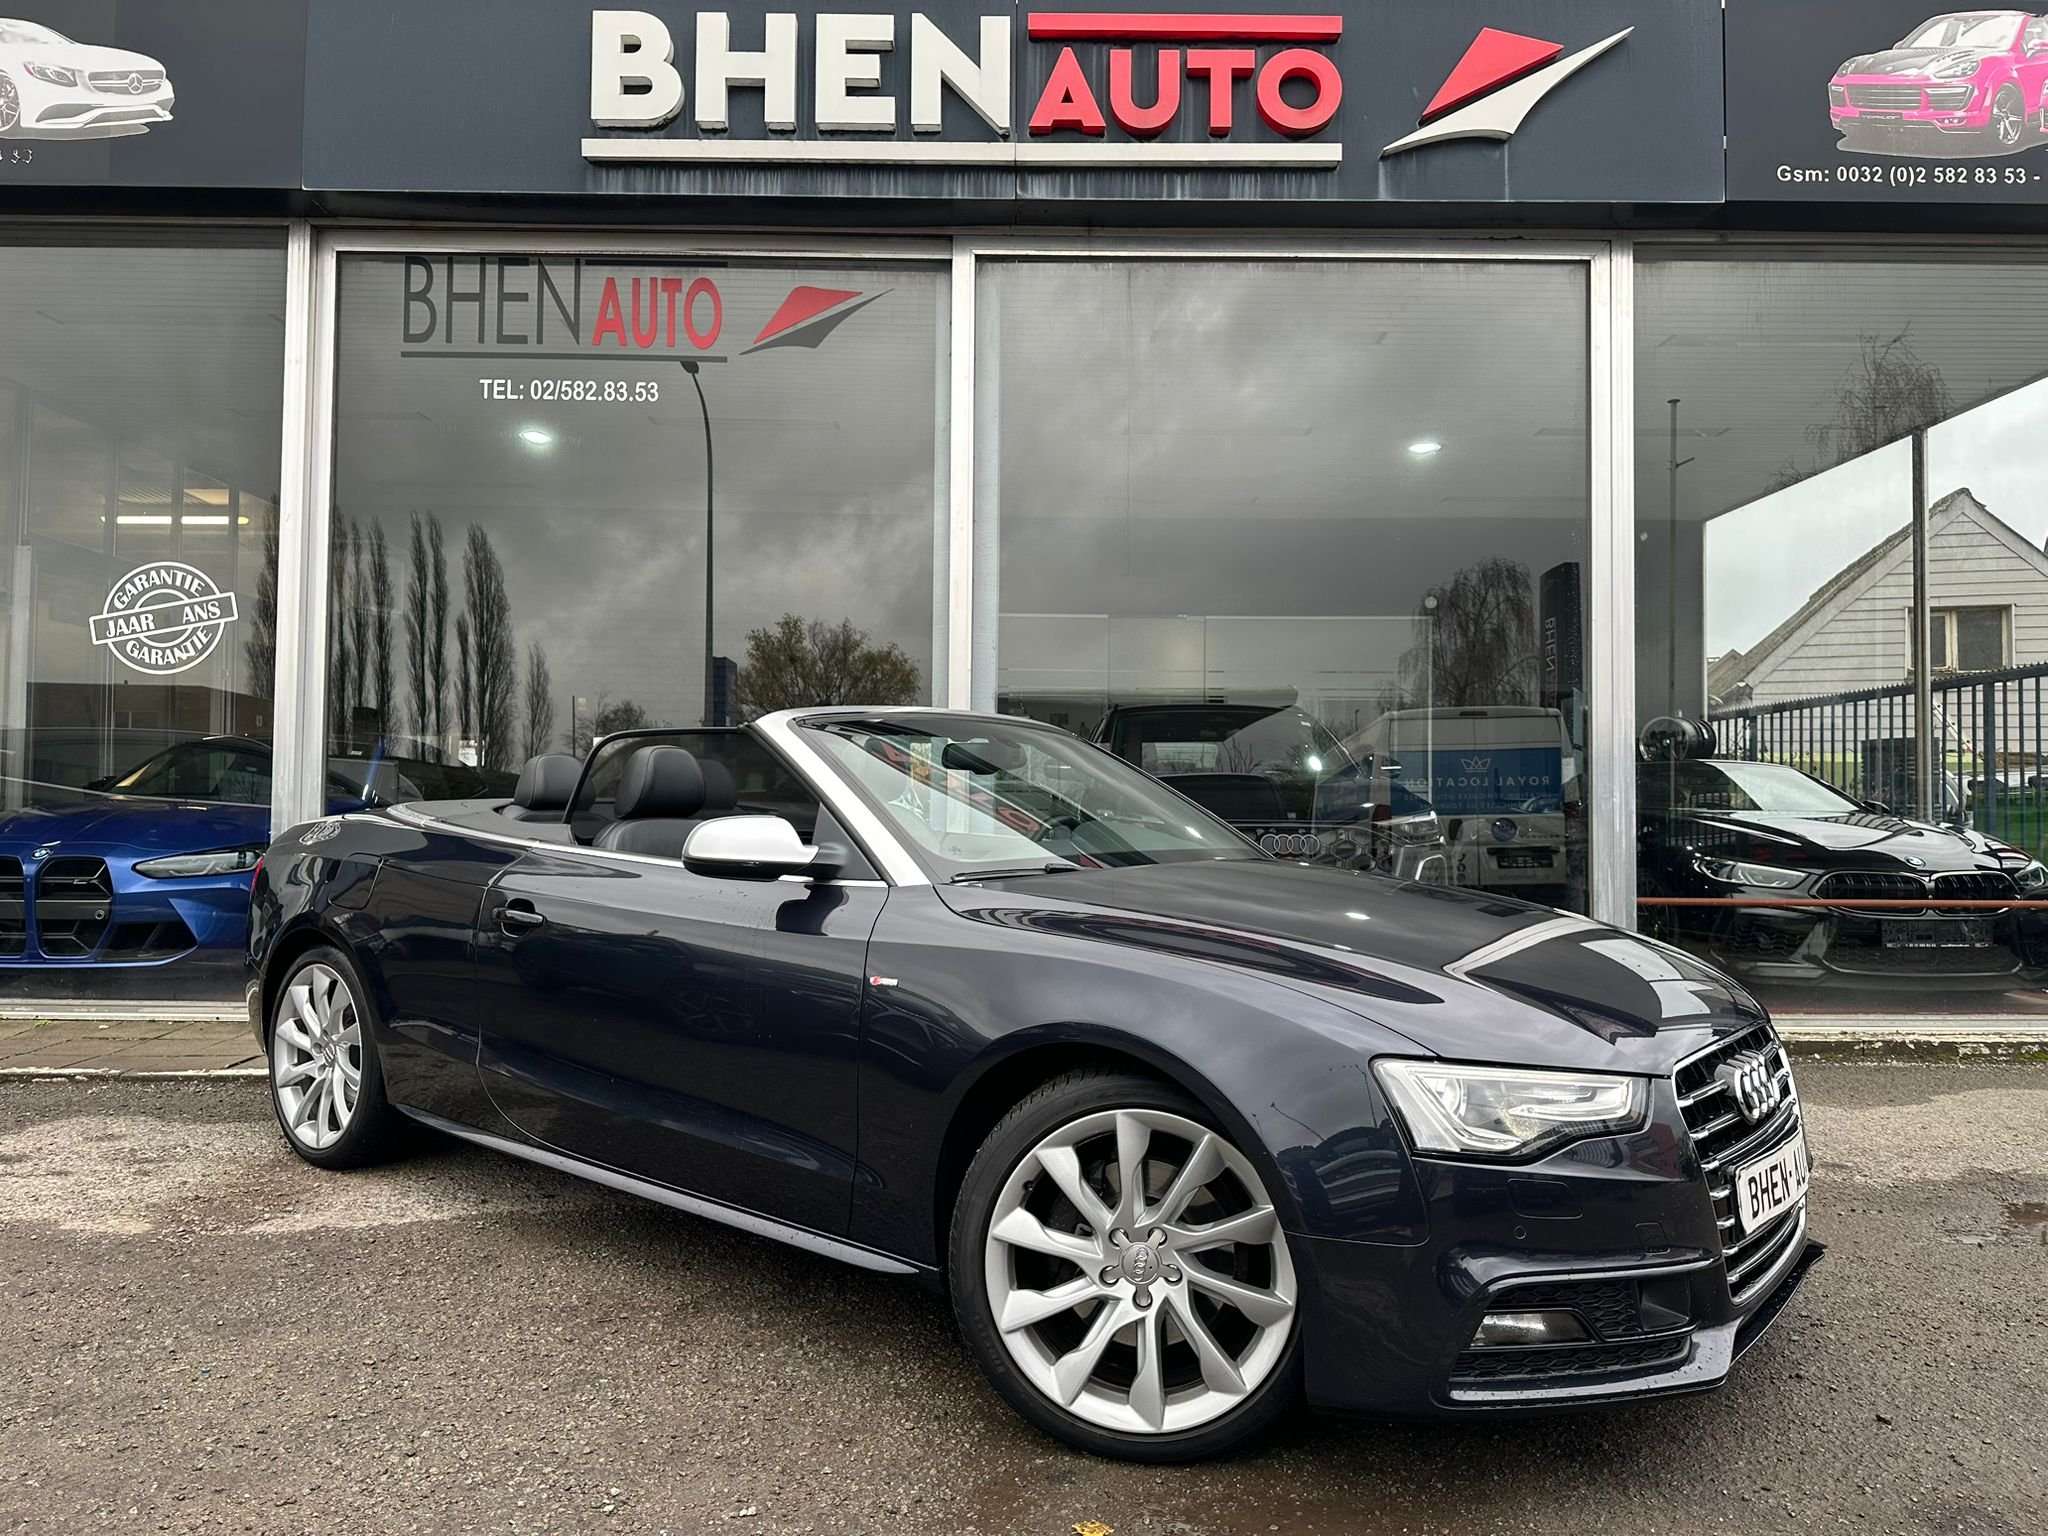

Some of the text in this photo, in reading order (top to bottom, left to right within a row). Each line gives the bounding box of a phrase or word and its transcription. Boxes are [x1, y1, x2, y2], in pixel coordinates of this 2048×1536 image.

[591, 10, 1343, 138] BHEN AUTO
[1777, 165, 1830, 182] Gsm:
[1837, 166, 1883, 183] 0032
[1890, 166, 1926, 187] (0)2
[1934, 167, 1968, 184] 582
[1974, 167, 1998, 184] 83
[2004, 167, 2027, 184] 53
[402, 255, 723, 350] BHEN AUTO
[479, 379, 660, 402] TEL: 02/582.83.53
[113, 568, 205, 610] GARANTIE
[106, 600, 221, 639] JAAR ANS
[126, 627, 213, 666] GARANTIE
